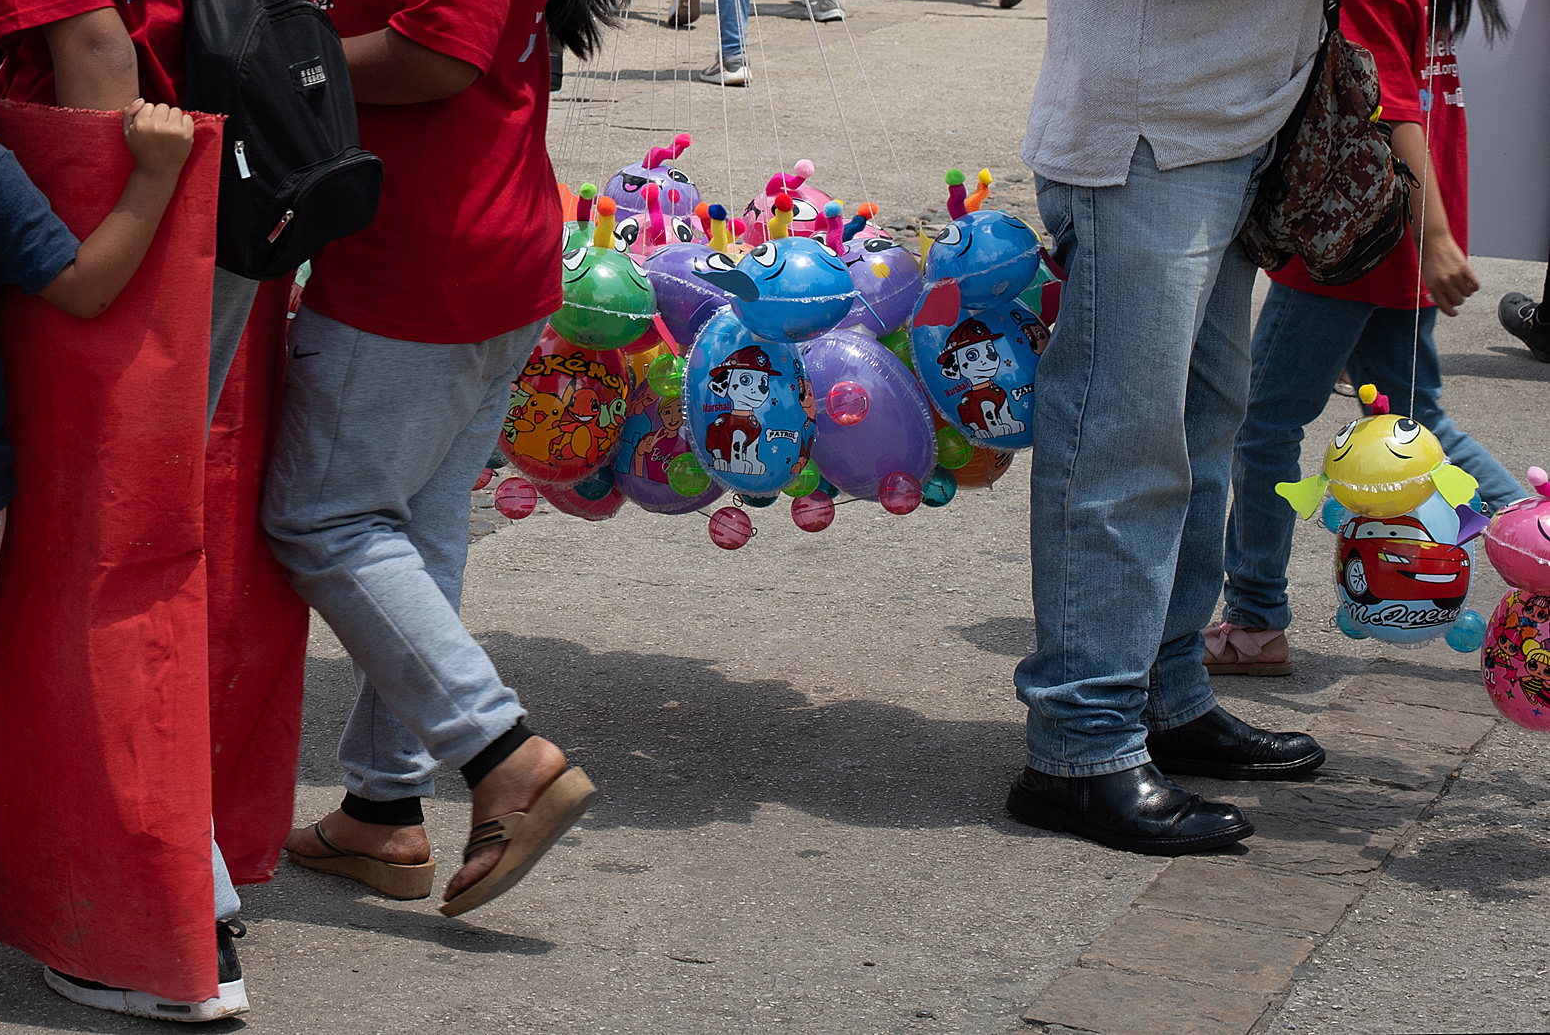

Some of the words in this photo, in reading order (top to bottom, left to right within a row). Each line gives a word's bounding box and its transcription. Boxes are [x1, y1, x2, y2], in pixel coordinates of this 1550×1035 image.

[702, 400, 732, 414] Marshall
[769, 430, 795, 440] PATROL
[1344, 602, 1461, 629] McQueen
